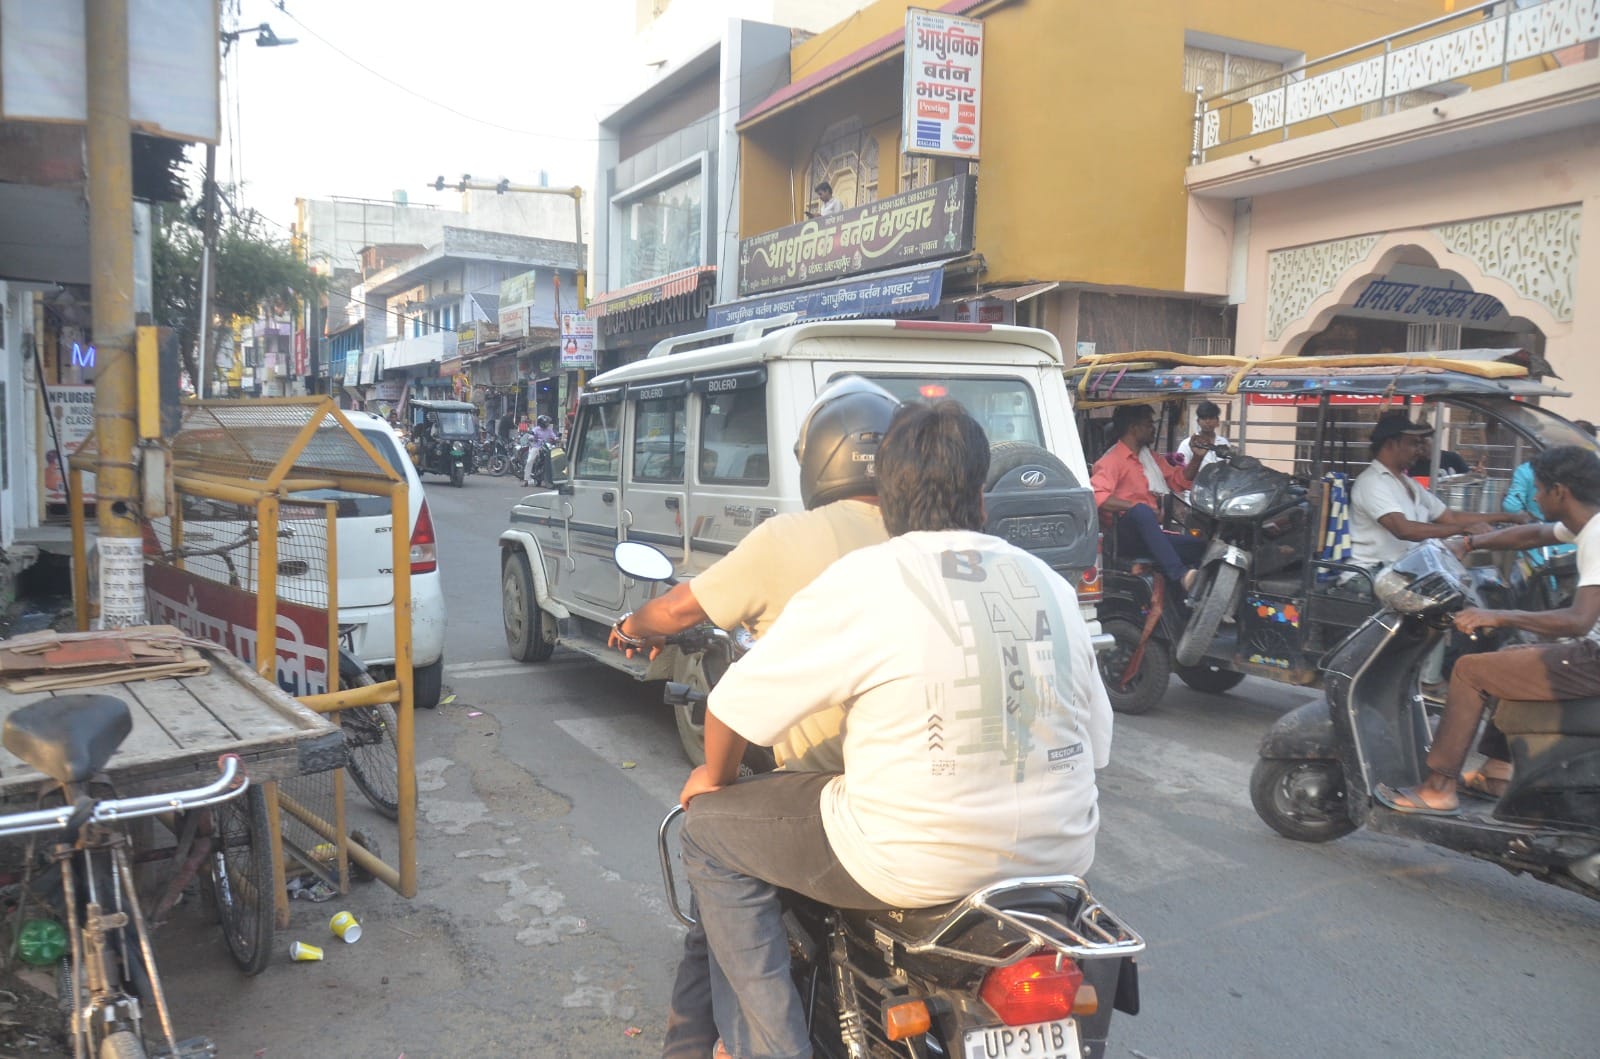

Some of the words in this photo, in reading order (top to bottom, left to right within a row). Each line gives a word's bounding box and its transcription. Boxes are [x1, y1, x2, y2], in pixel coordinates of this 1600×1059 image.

[917, 26, 981, 61] आधुनिक
[922, 59, 972, 83] बर्तन
[916, 80, 976, 103] भण्डार
[765, 221, 837, 278] आधुनिक
[839, 209, 879, 249] बर्तन
[879, 199, 936, 238] भण्डार
[820, 288, 858, 309] आधुनिक
[882, 281, 914, 297] भण्डार
[640, 388, 663, 400] BOLERO
[708, 378, 737, 392] BOLERO
[1007, 521, 1065, 540] BOLERO
[985, 1022, 1064, 1059] UP31B
